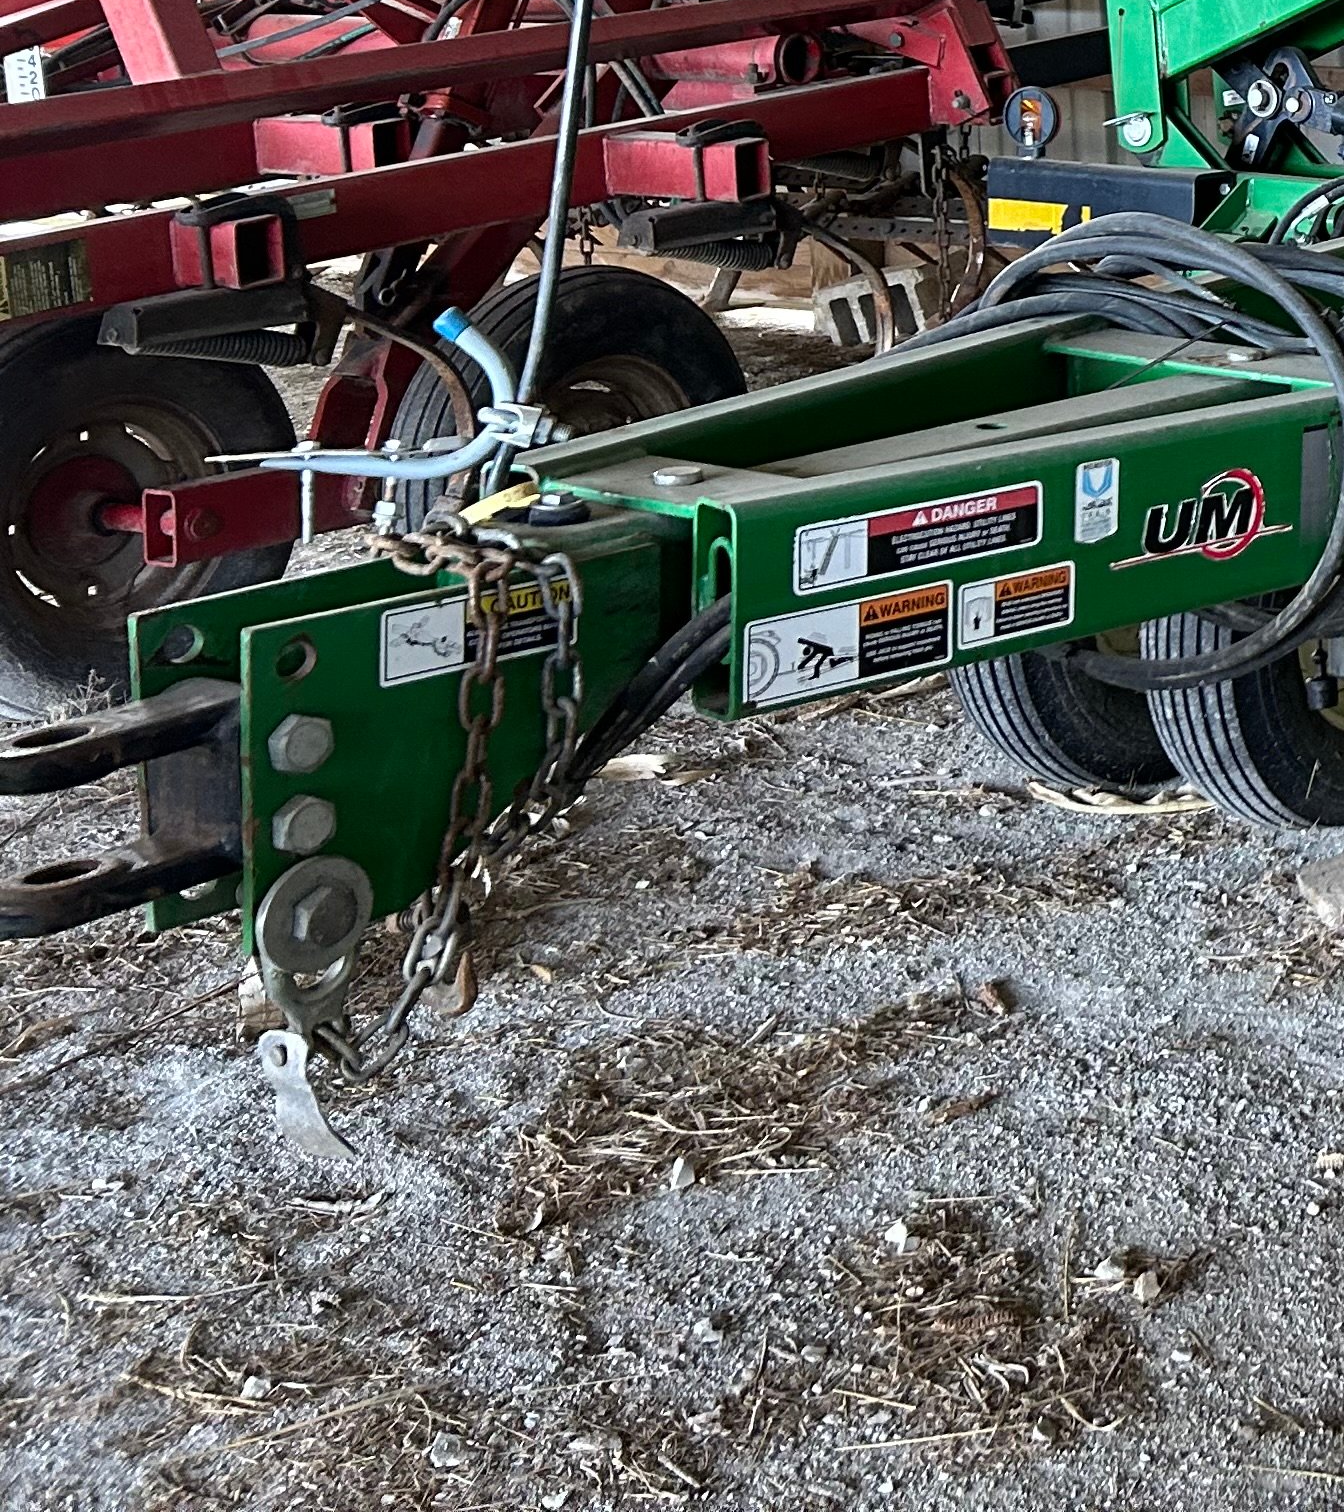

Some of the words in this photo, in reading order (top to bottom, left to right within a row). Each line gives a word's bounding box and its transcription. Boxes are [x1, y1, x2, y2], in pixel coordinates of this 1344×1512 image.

[28, 54, 36, 68] 4
[29, 70, 38, 85] 2
[931, 496, 998, 523] DANGER
[1143, 487, 1257, 555] UM
[1013, 571, 1067, 594] WARNING
[492, 583, 570, 612] CAUTON
[879, 592, 945, 618] WARNING
